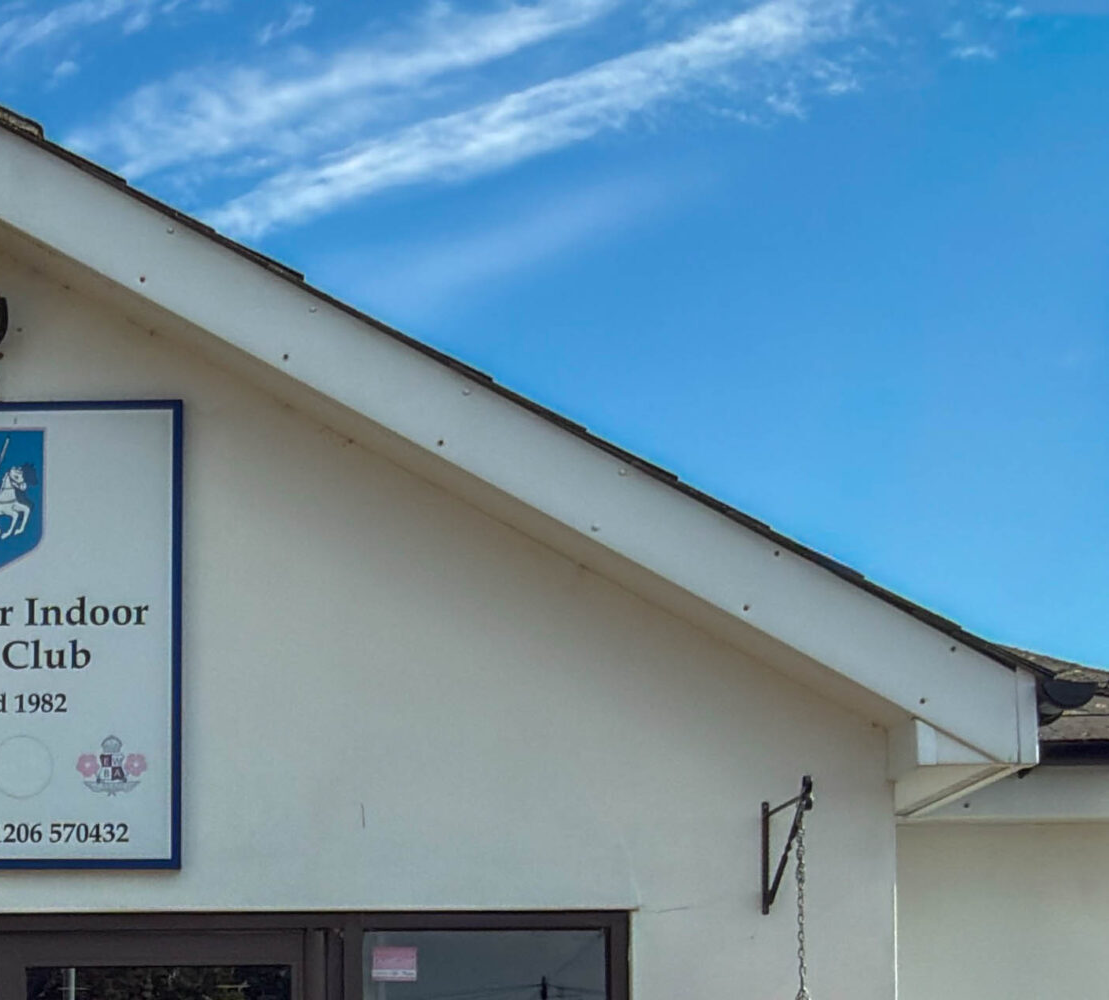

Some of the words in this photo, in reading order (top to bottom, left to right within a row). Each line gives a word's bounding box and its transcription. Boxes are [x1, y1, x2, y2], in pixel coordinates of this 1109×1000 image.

[24, 596, 149, 626] Indoor
[2, 640, 92, 670] Club
[14, 693, 68, 714] 1982
[48, 823, 129, 843] 570432
